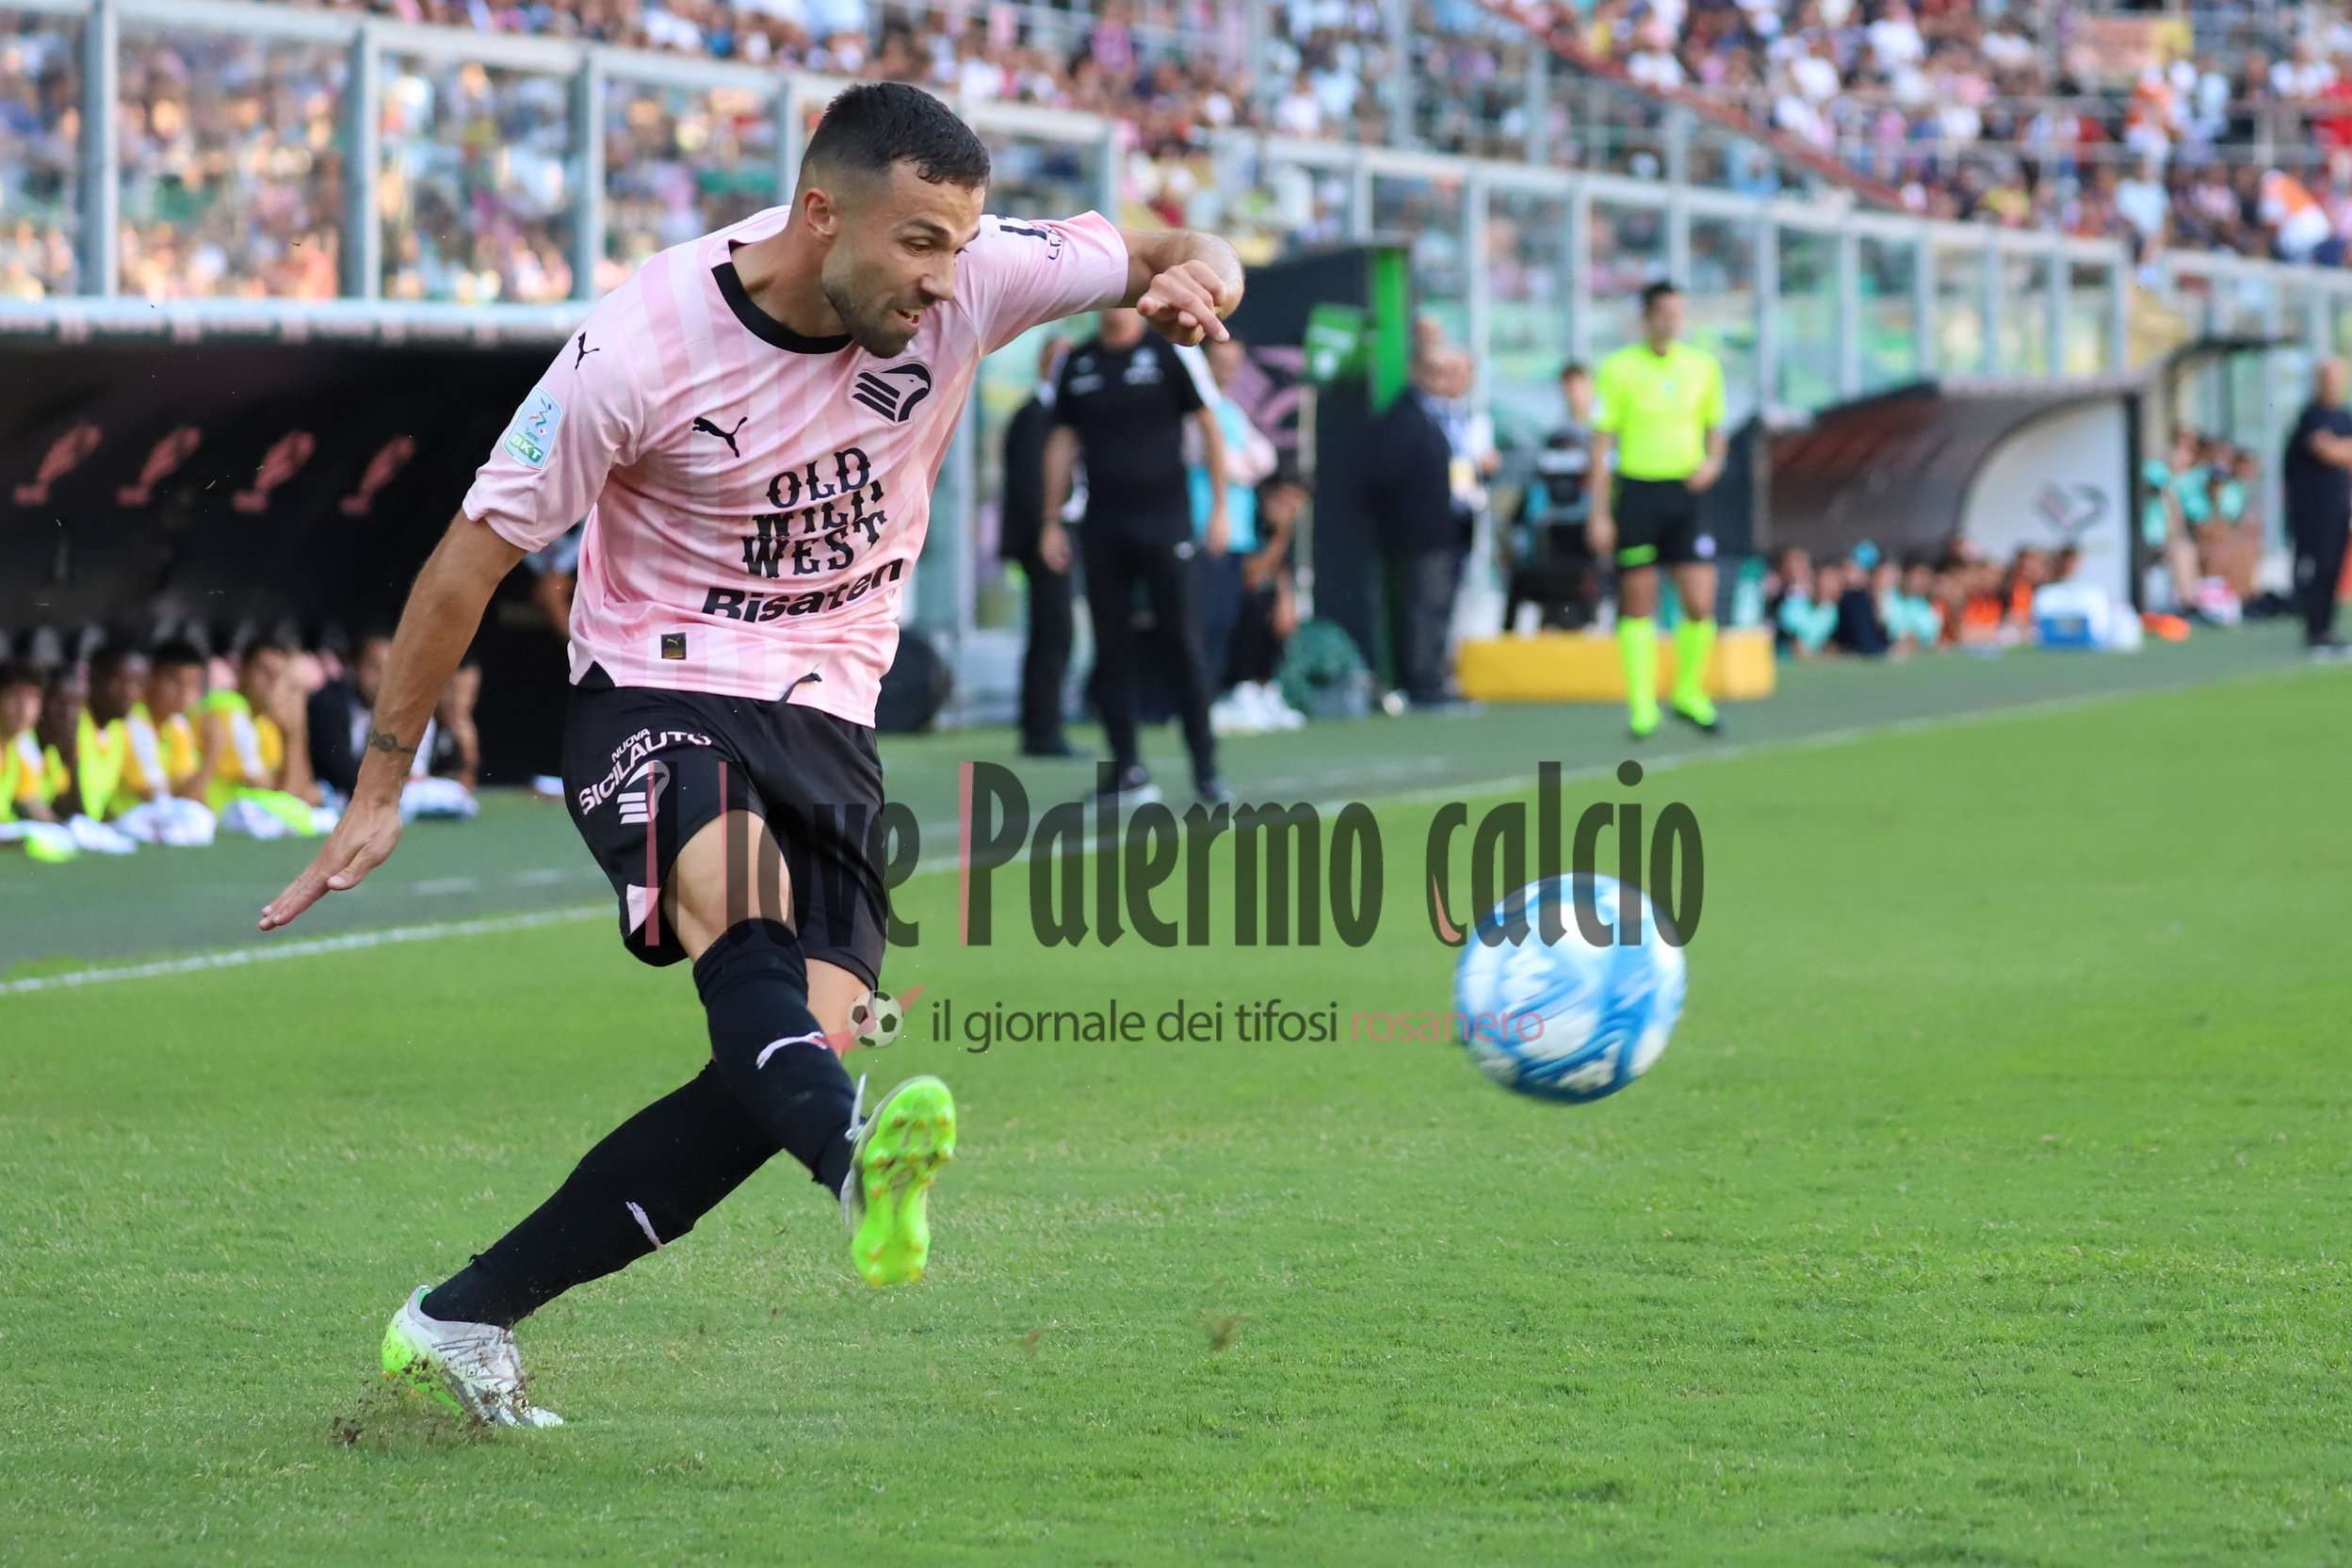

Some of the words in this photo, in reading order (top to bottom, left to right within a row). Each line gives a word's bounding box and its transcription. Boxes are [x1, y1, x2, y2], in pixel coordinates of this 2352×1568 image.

[511, 433, 543, 462] BKT
[766, 447, 871, 509] OLD
[741, 509, 887, 578] WEST
[578, 731, 712, 816] SICILAUTO
[611, 728, 651, 763] NUOVA
